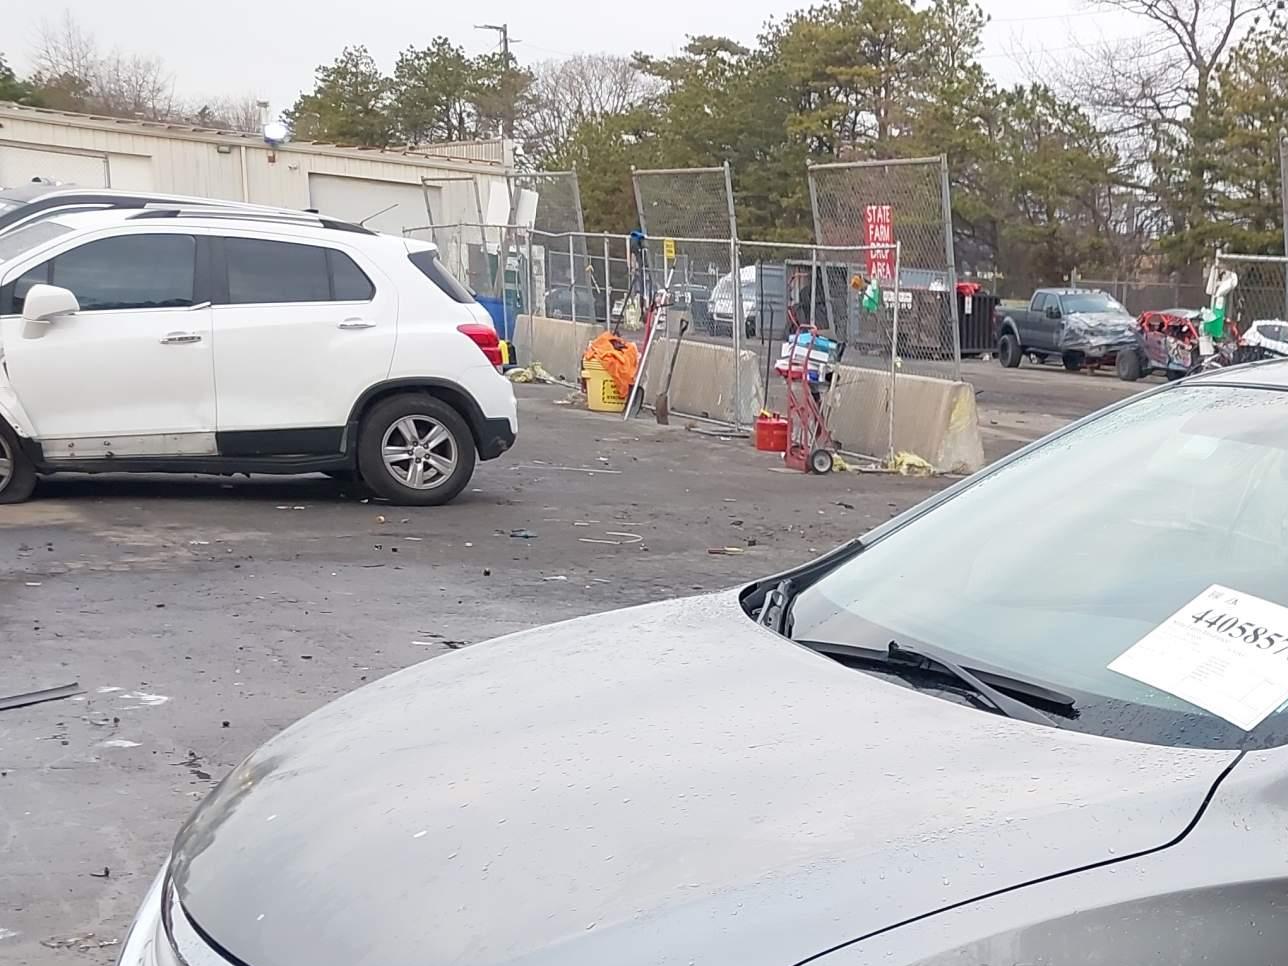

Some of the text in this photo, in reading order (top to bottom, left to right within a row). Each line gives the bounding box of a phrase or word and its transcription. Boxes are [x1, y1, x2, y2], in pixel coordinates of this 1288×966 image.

[866, 204, 891, 223] STATE
[869, 224, 891, 242] FARM
[870, 262, 891, 279] AREA
